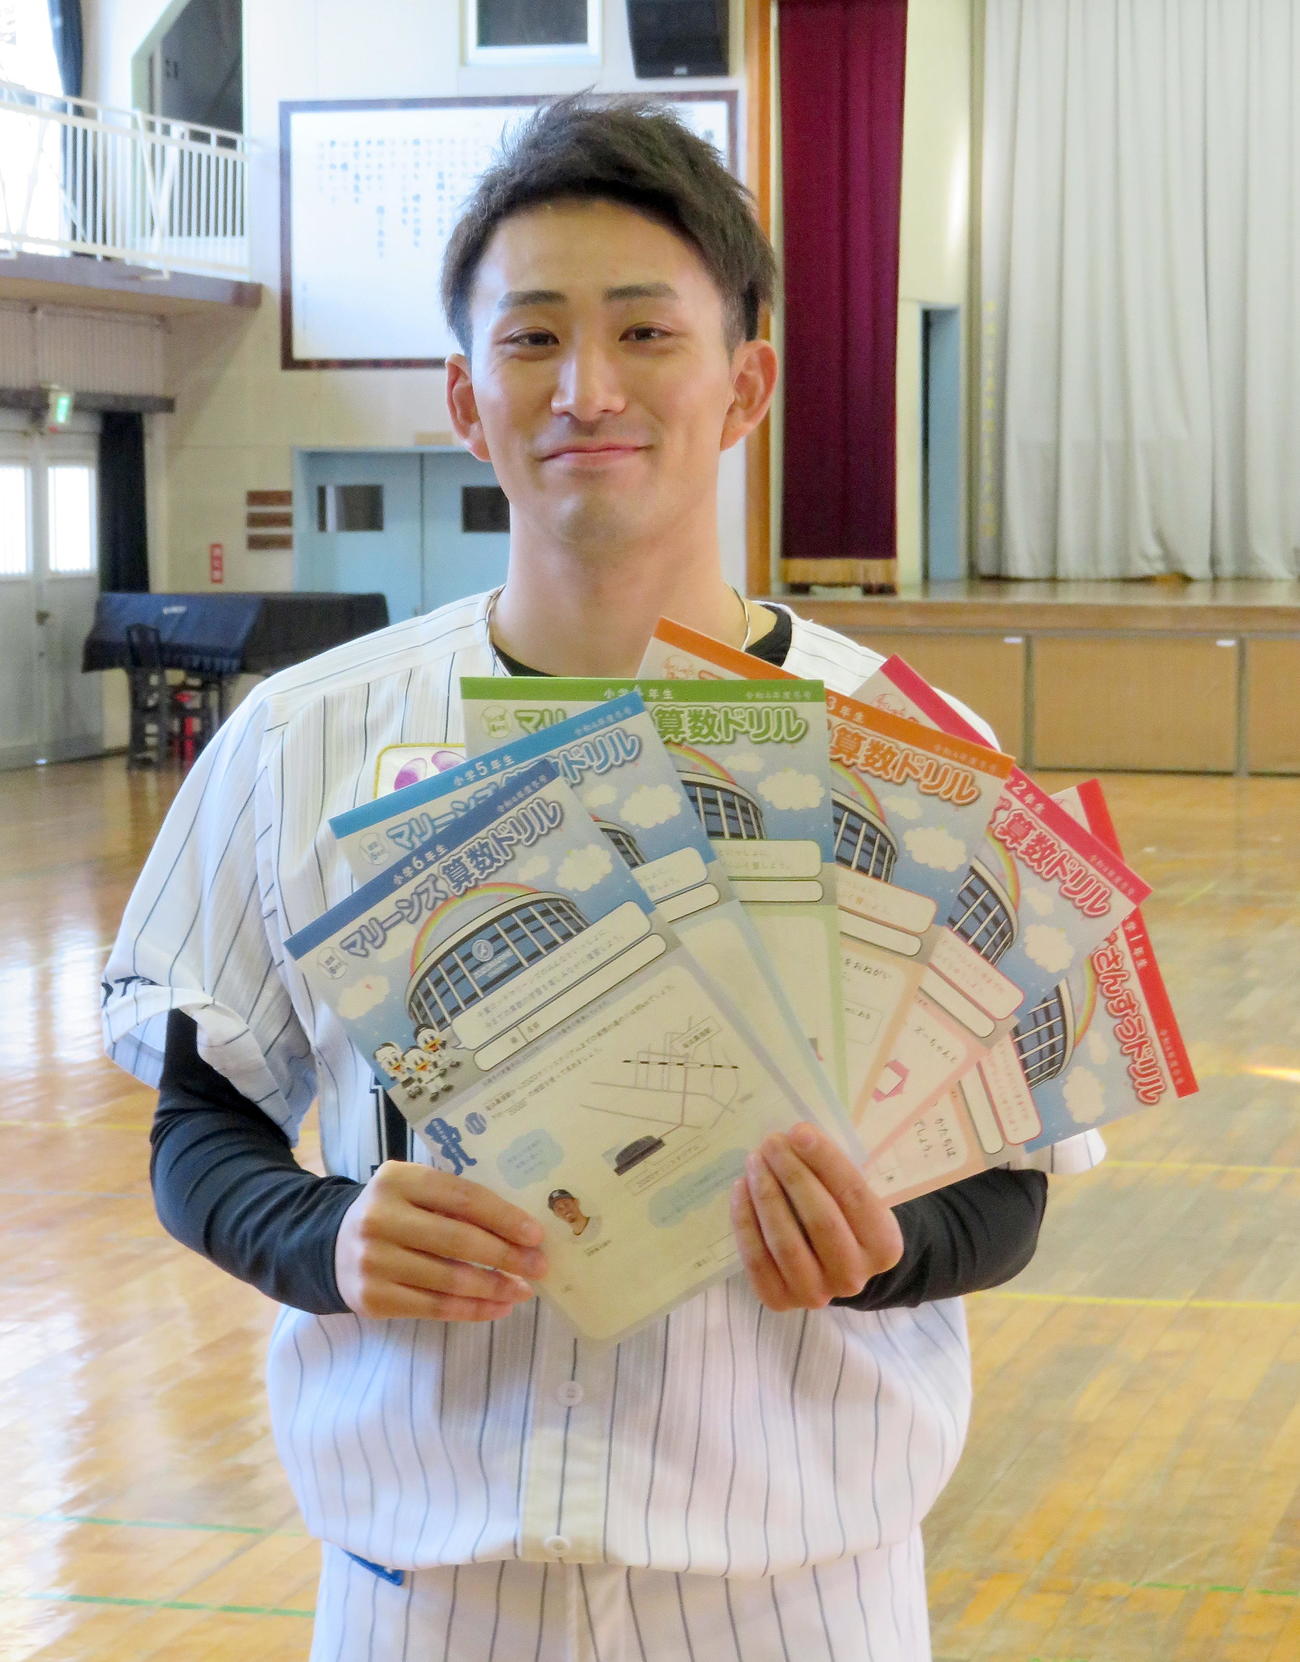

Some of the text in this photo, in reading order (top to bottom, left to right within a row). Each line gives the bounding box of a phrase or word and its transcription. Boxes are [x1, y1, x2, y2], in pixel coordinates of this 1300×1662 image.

[454, 754, 515, 786] 小学5年生
[827, 721, 982, 805] 算数ドリル
[392, 844, 449, 886] 小学6年生
[1091, 928, 1167, 1106] さんすうドリル
